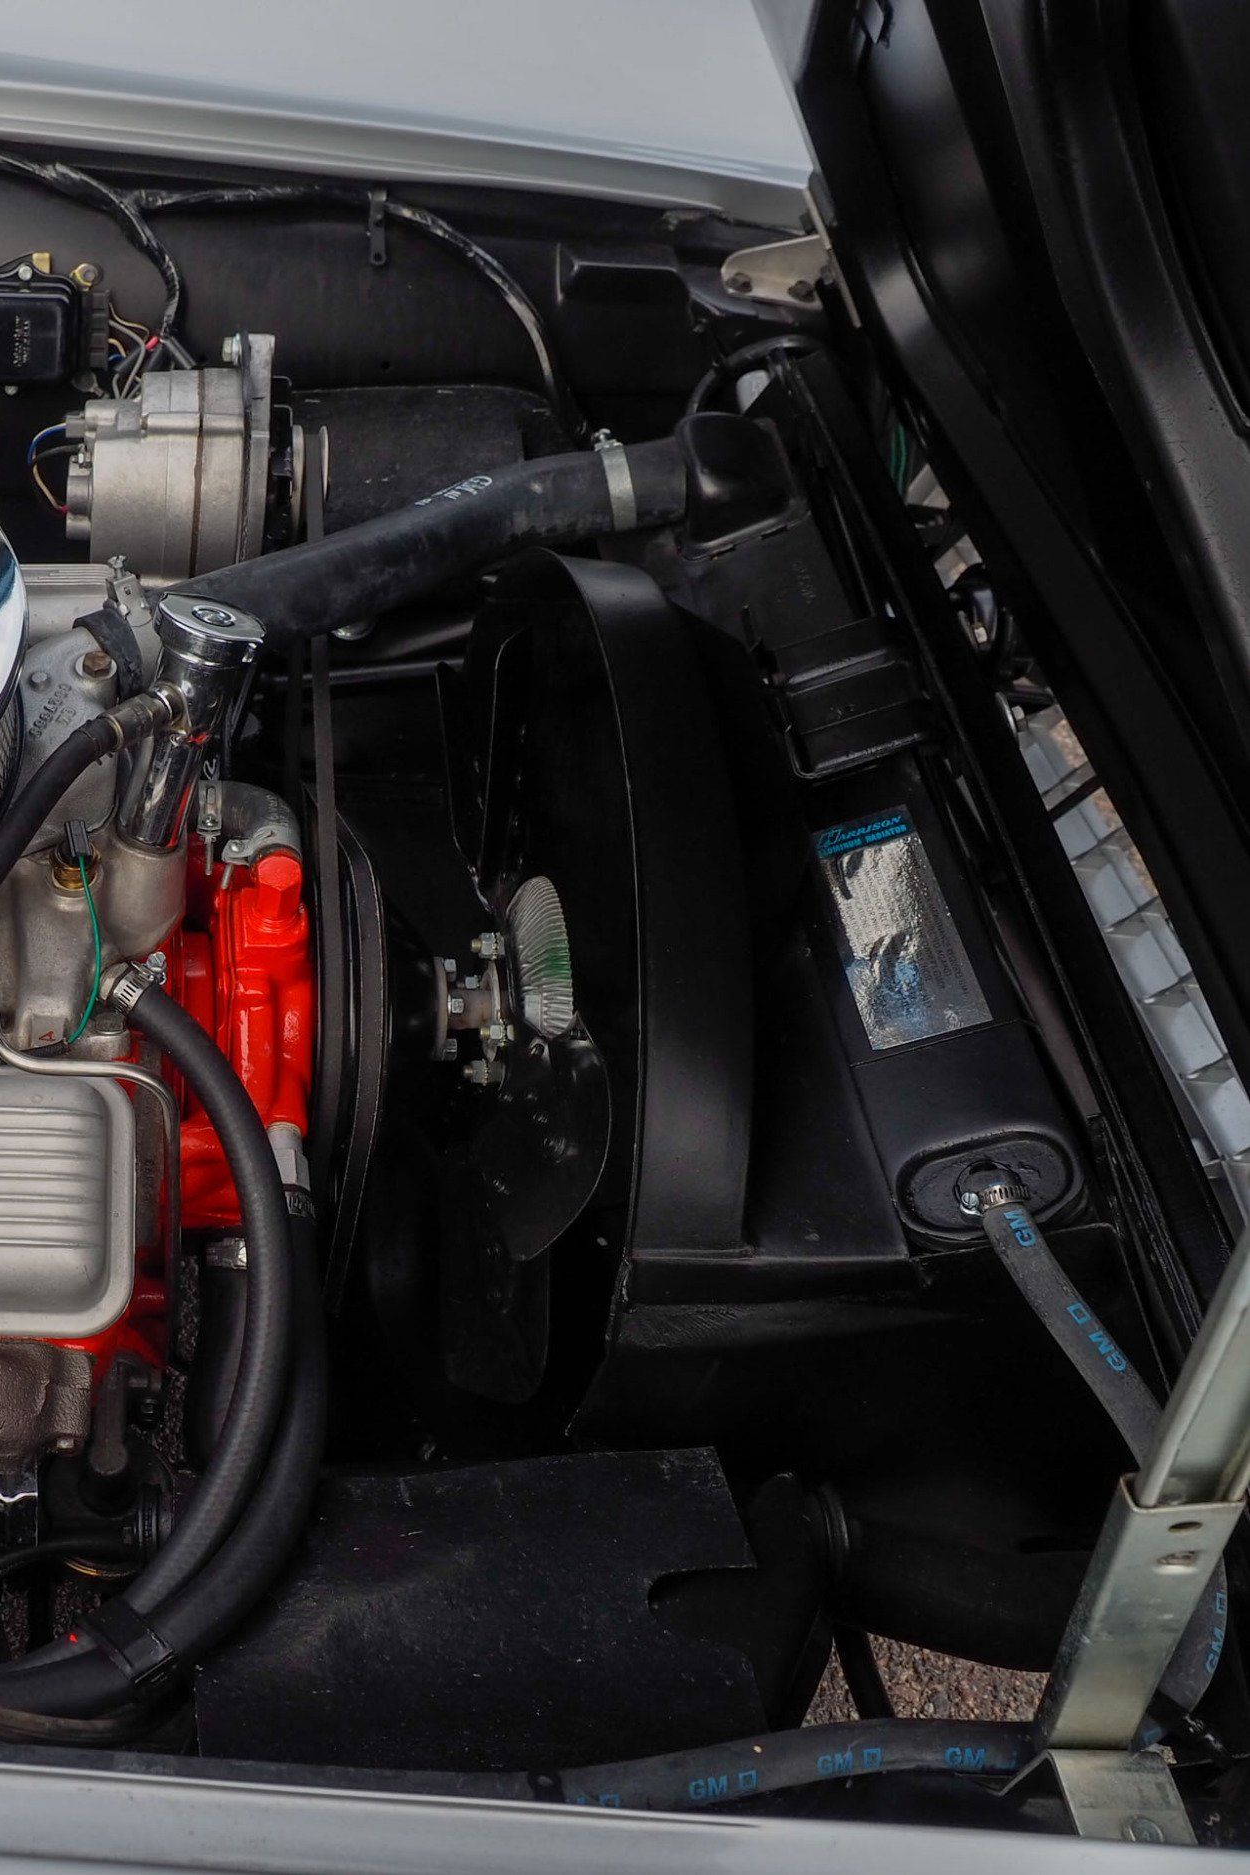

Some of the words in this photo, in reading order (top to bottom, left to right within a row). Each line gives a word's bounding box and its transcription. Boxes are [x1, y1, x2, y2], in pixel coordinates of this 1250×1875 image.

[1003, 1208, 1036, 1248] GM
[1088, 1330, 1128, 1373] GM
[816, 1750, 854, 1775] GM
[944, 1746, 986, 1770] GM
[688, 1774, 729, 1800] GM
